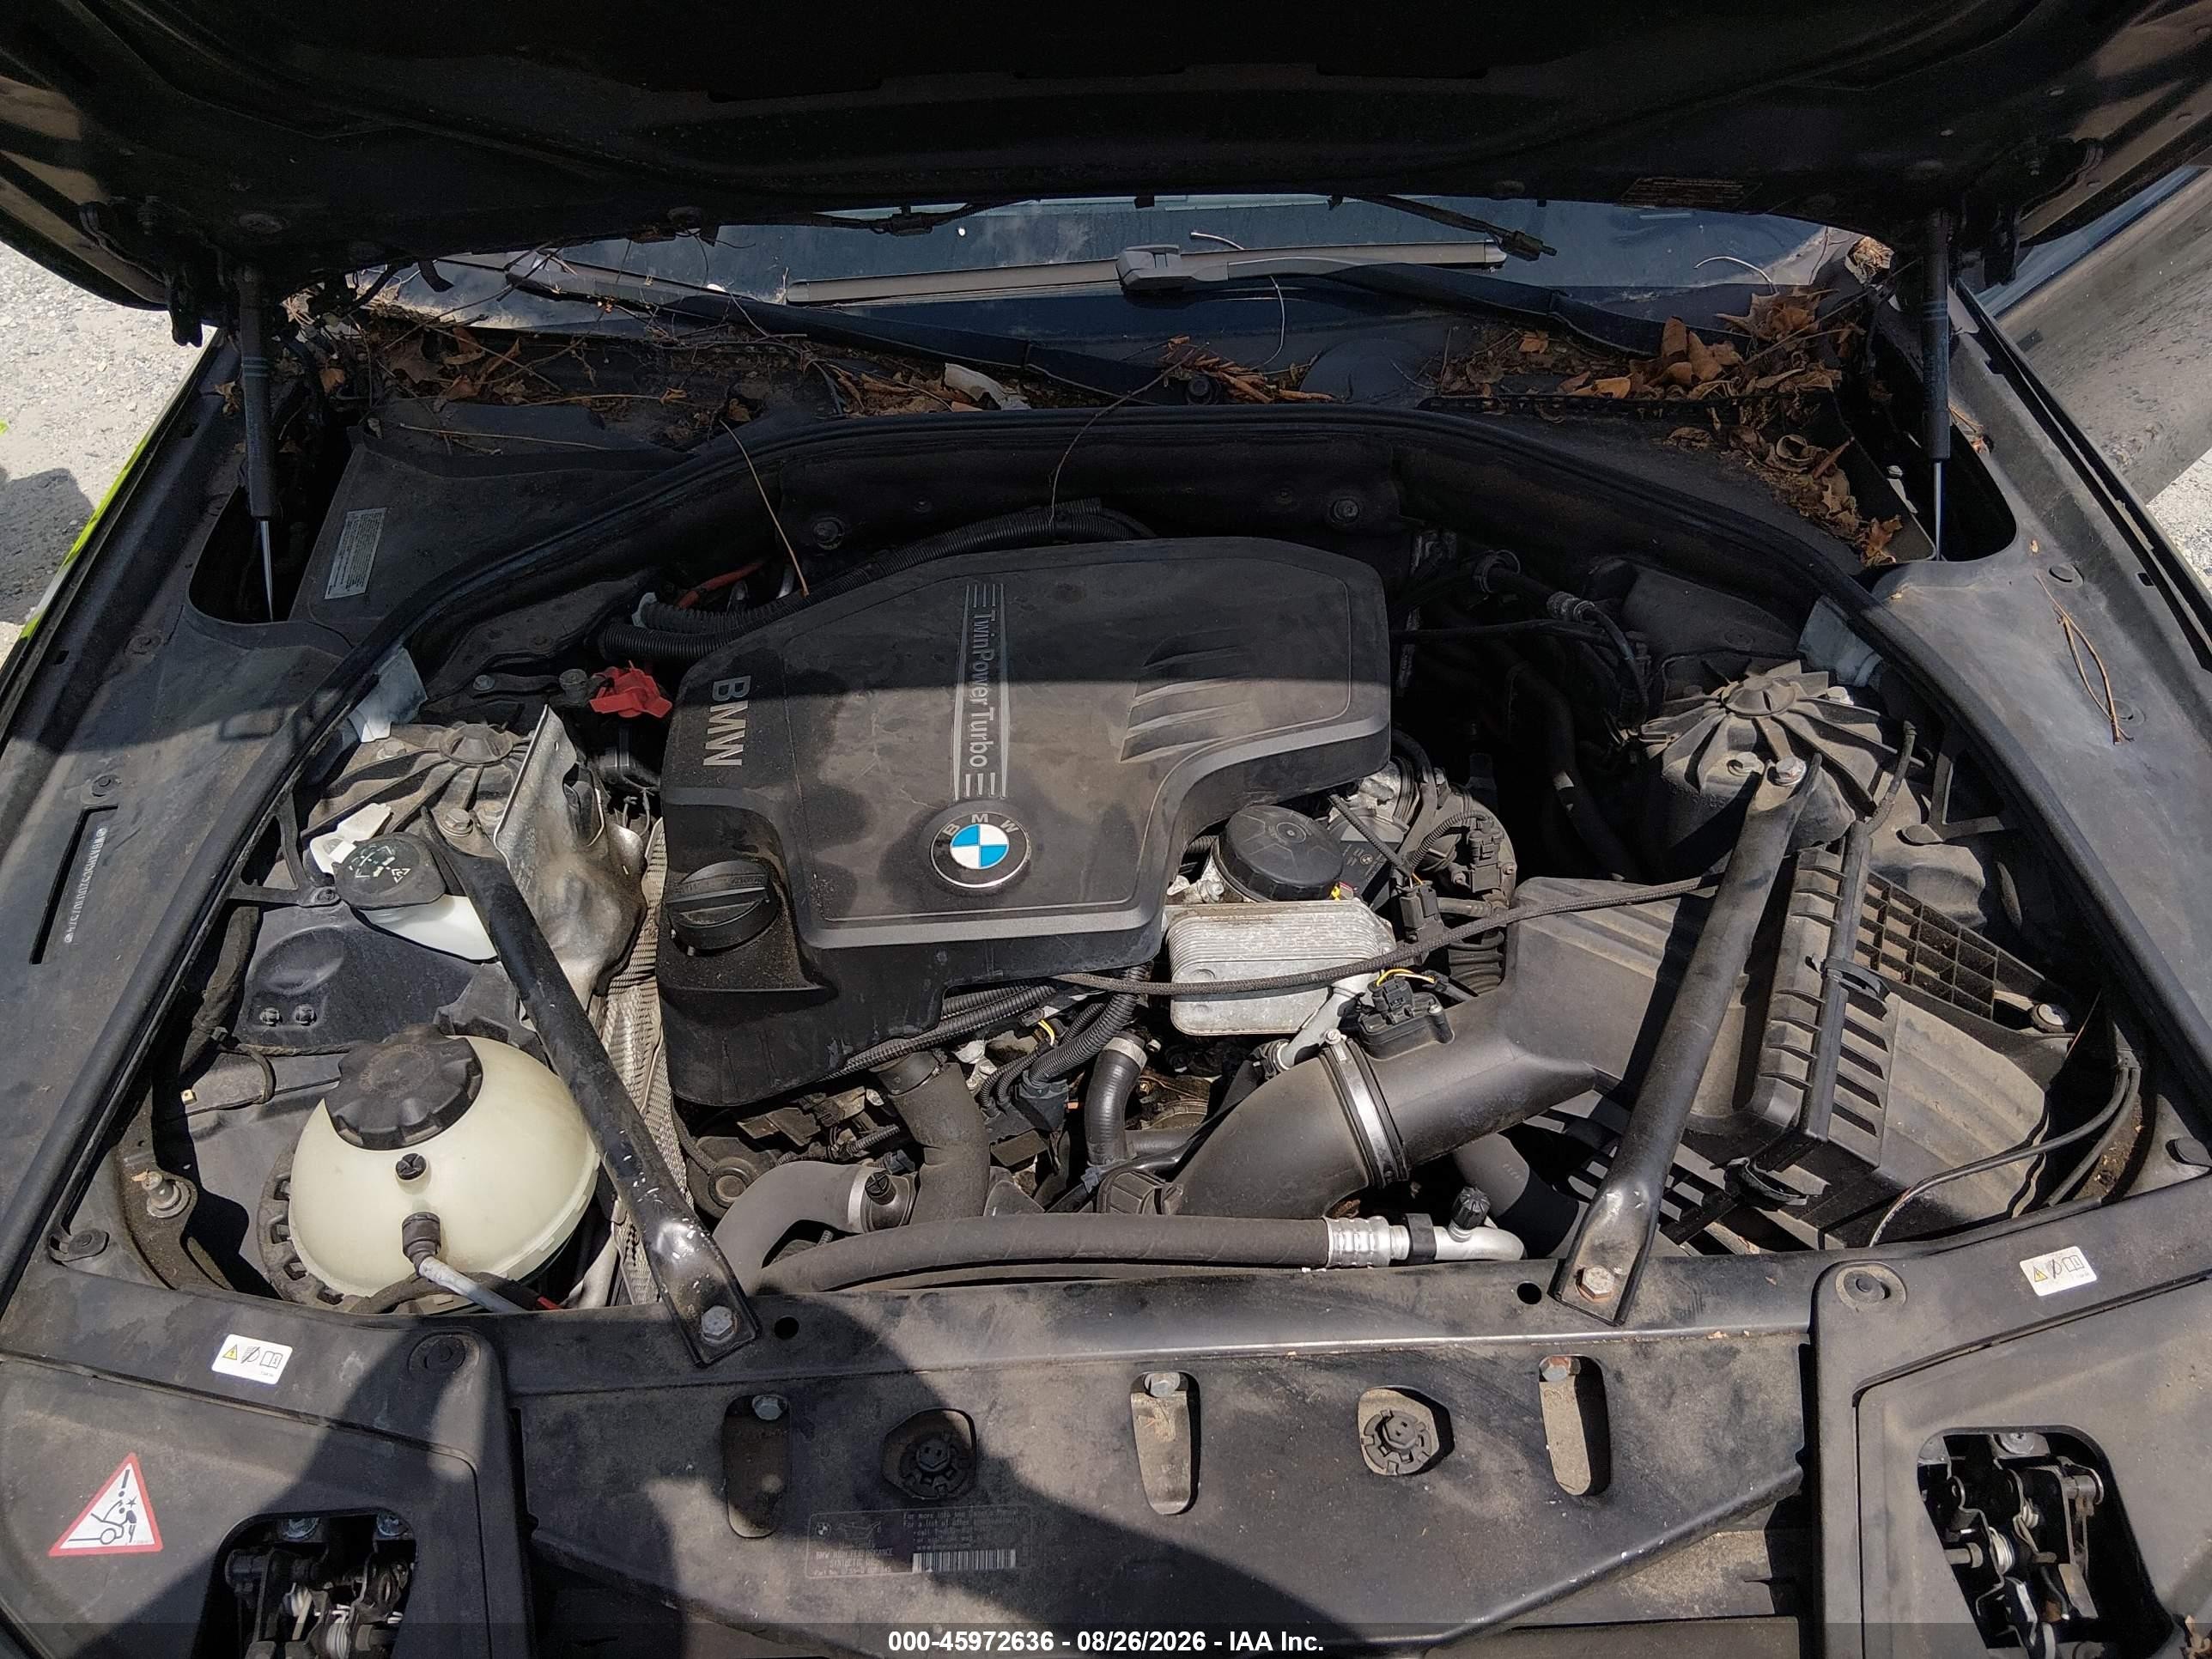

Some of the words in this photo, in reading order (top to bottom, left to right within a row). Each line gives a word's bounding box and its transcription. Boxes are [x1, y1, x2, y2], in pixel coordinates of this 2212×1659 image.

[968, 609, 997, 706] TwinPower
[703, 675, 751, 766] BMW
[969, 707, 994, 768] Turbo
[942, 813, 1019, 836] BMW
